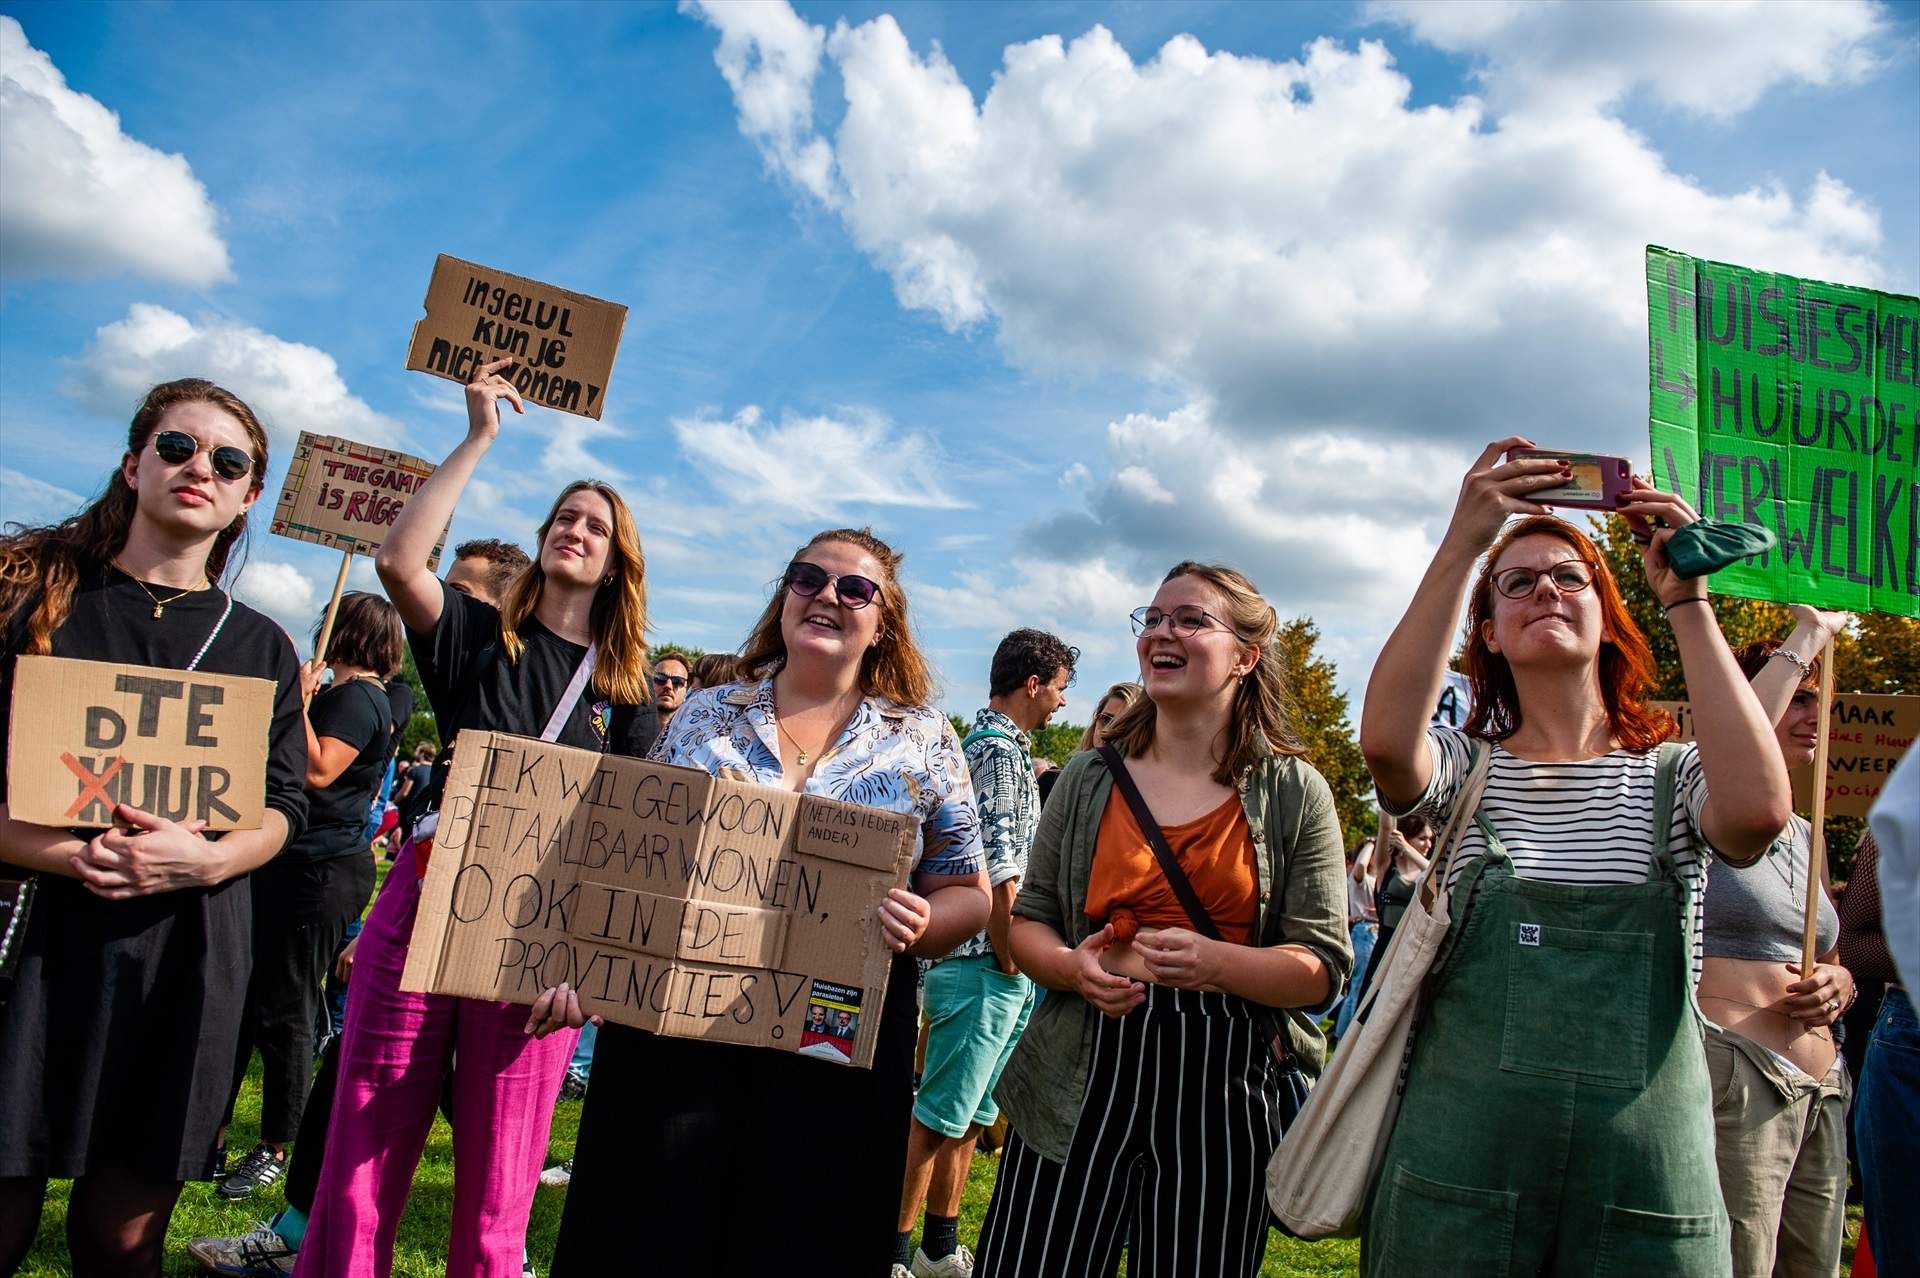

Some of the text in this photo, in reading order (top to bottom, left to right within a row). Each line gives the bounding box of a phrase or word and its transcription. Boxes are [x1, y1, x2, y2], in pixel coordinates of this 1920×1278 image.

[323, 459, 368, 483] THE
[85, 706, 126, 749] D
[115, 674, 224, 747] TE
[471, 746, 785, 840] IK WIL GEWOON
[832, 810, 857, 826] ALS
[861, 813, 900, 837] IEDER
[439, 795, 829, 924] BETAALBAAR WONEN,
[451, 864, 748, 958] OOK IN DE
[811, 990, 844, 1002] parasieten
[813, 981, 846, 994] Huisbazen
